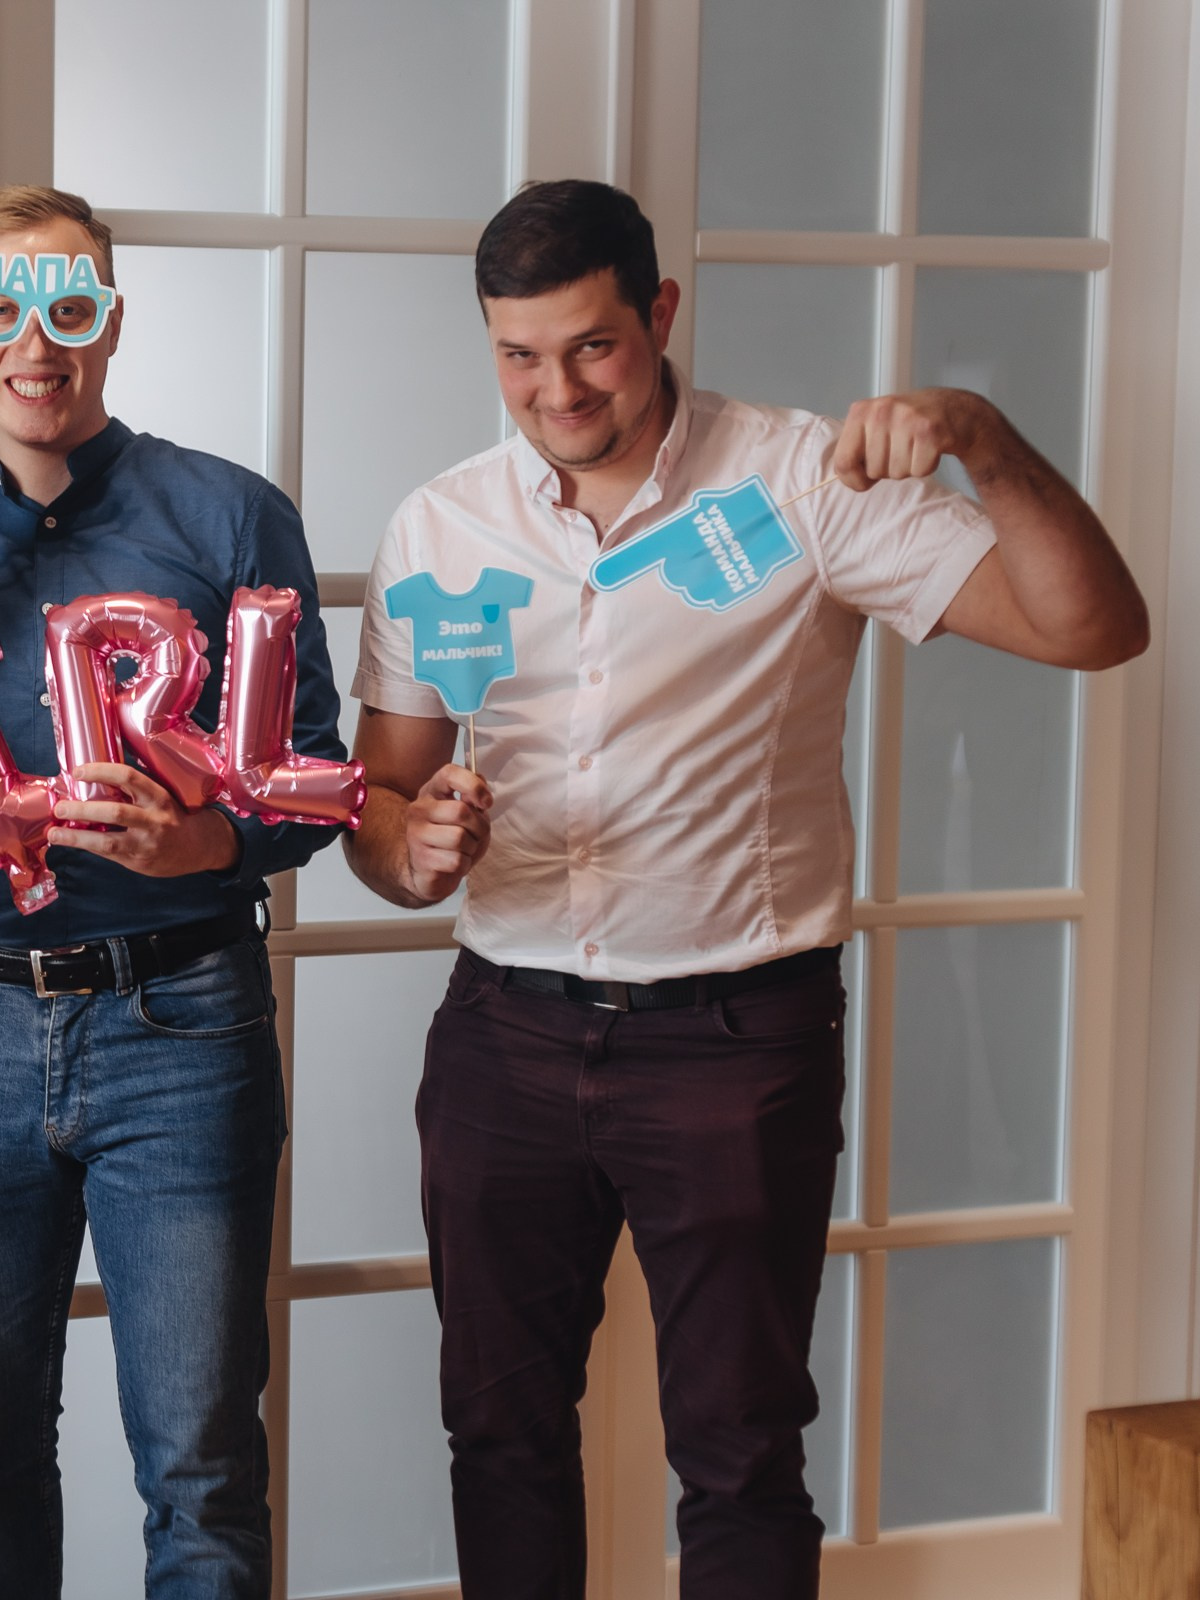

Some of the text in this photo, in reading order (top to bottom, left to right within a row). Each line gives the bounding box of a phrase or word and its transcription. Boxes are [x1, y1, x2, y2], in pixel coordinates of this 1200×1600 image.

[693, 511, 746, 593] КОМАНДА
[438, 620, 483, 636] Это
[422, 644, 503, 661] МАЛЬЧИК!
